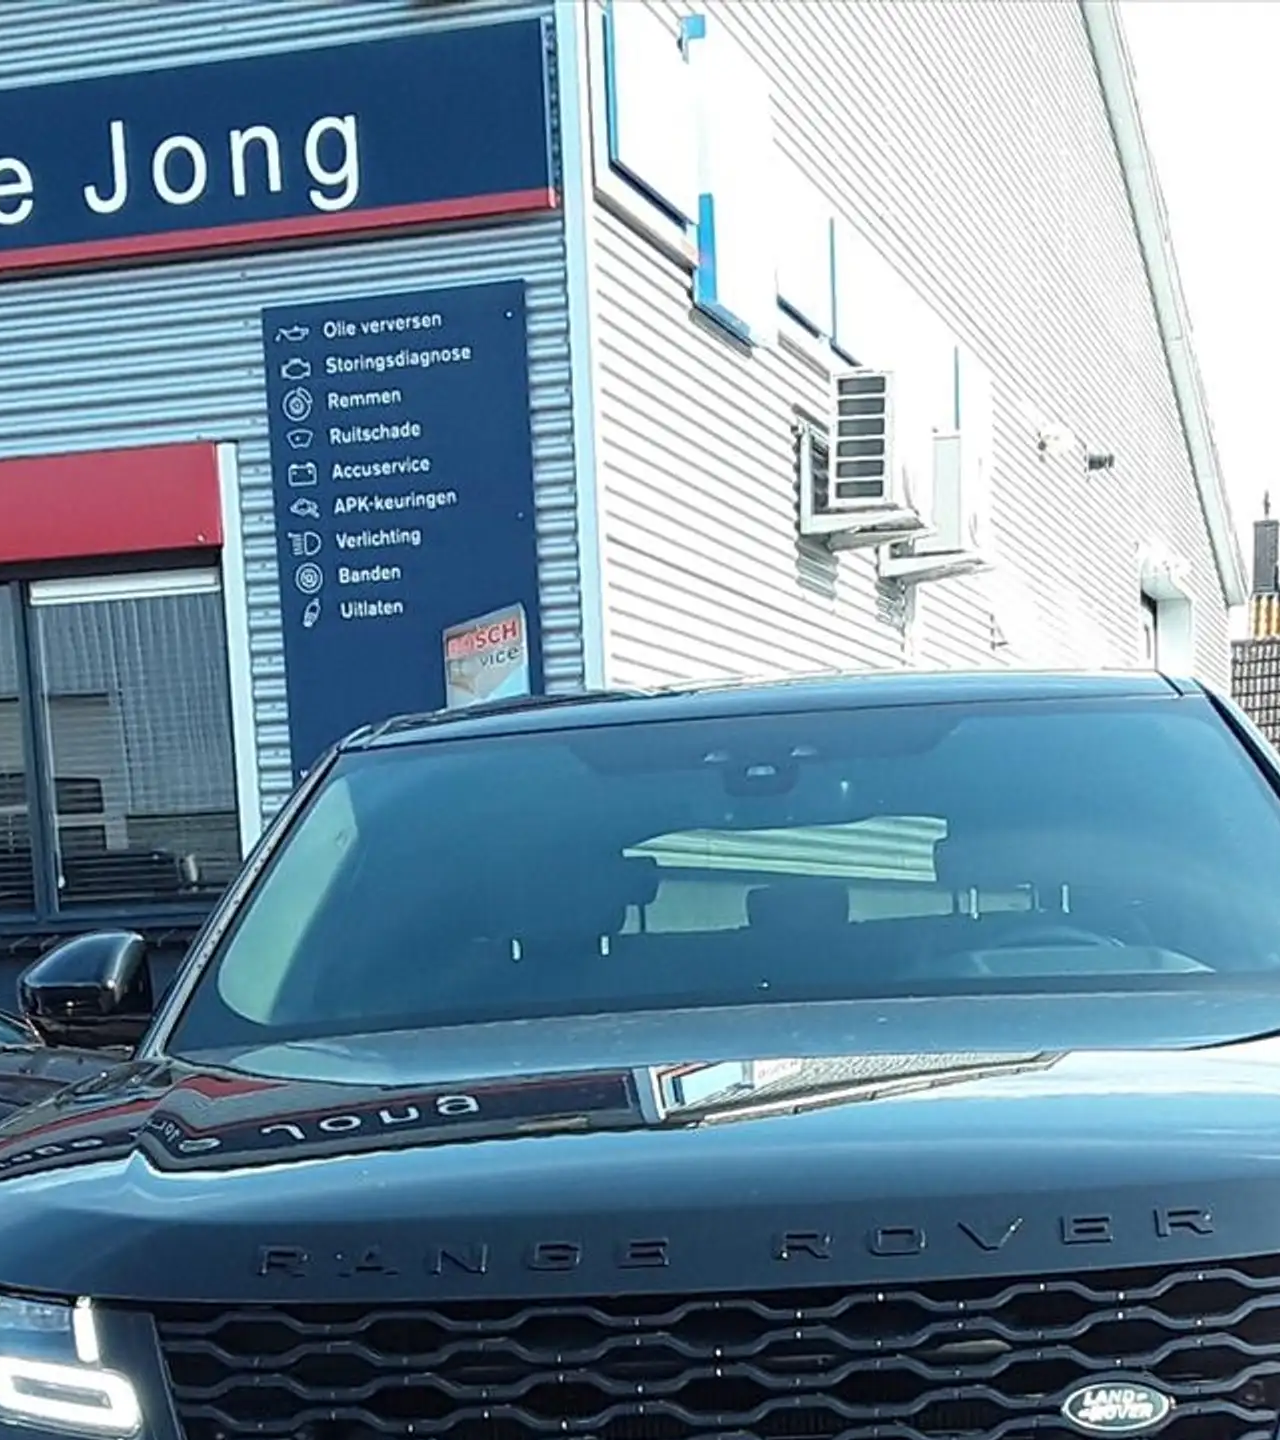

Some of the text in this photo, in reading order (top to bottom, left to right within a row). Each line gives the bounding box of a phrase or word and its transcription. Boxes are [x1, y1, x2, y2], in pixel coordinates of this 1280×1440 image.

[83, 112, 361, 212] Jong
[324, 313, 442, 338] Olie verversen
[326, 345, 472, 374] Storingsdiagnose
[327, 388, 402, 410] Remmen
[330, 422, 421, 445] Ruitschade
[332, 457, 432, 480] Accuservice
[334, 489, 457, 514] APK-keuringen
[336, 527, 422, 550] Verlichting
[339, 565, 401, 585] Banden
[341, 600, 404, 619] Uitlaten
[449, 620, 517, 653] SCH
[257, 1204, 1214, 1278] RANGE ROVER
